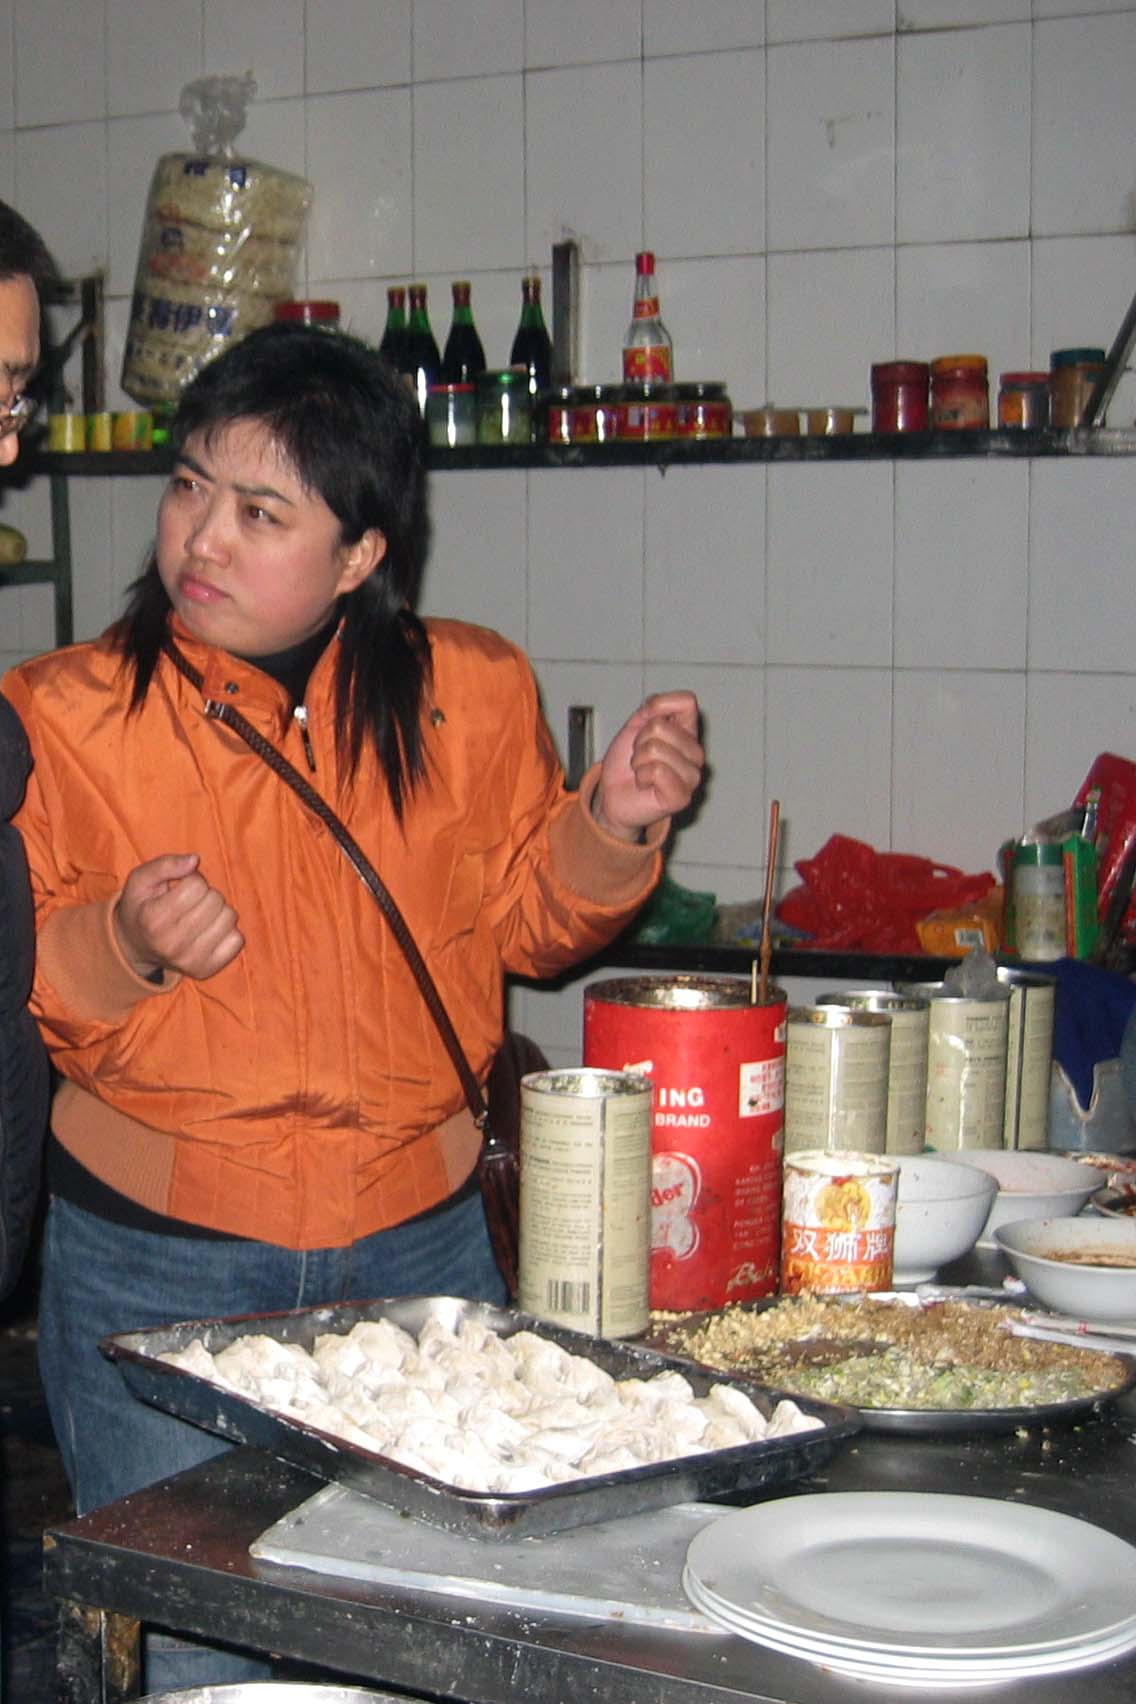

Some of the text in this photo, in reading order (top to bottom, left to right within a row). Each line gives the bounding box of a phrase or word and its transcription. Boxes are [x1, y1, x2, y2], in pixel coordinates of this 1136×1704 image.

[659, 1087, 704, 1107] ING
[655, 1112, 712, 1128] BRAND
[791, 1229, 889, 1263] 双狮牌
